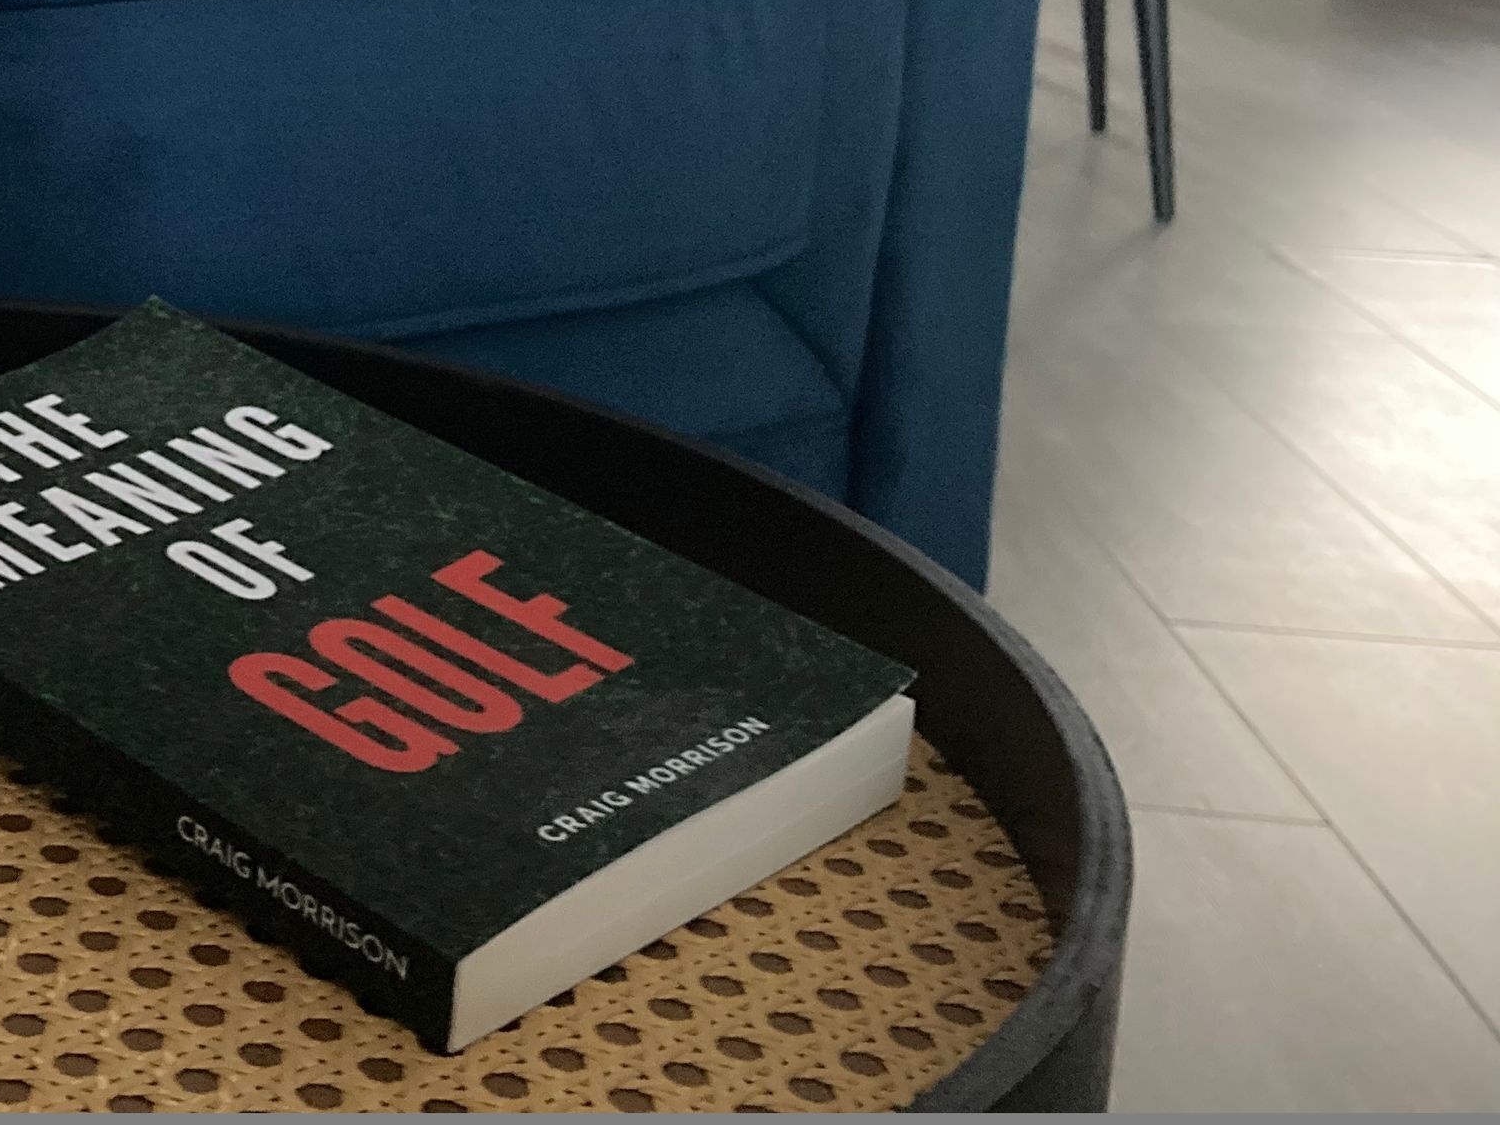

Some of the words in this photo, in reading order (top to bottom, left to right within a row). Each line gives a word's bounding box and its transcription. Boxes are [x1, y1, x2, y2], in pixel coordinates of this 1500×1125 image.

[166, 518, 315, 601] OF
[228, 549, 636, 773] GOLF
[537, 789, 633, 843] CRAIG
[626, 715, 771, 799] MORRISON
[175, 814, 252, 880] CRAIG
[256, 863, 409, 981] MORRISON
